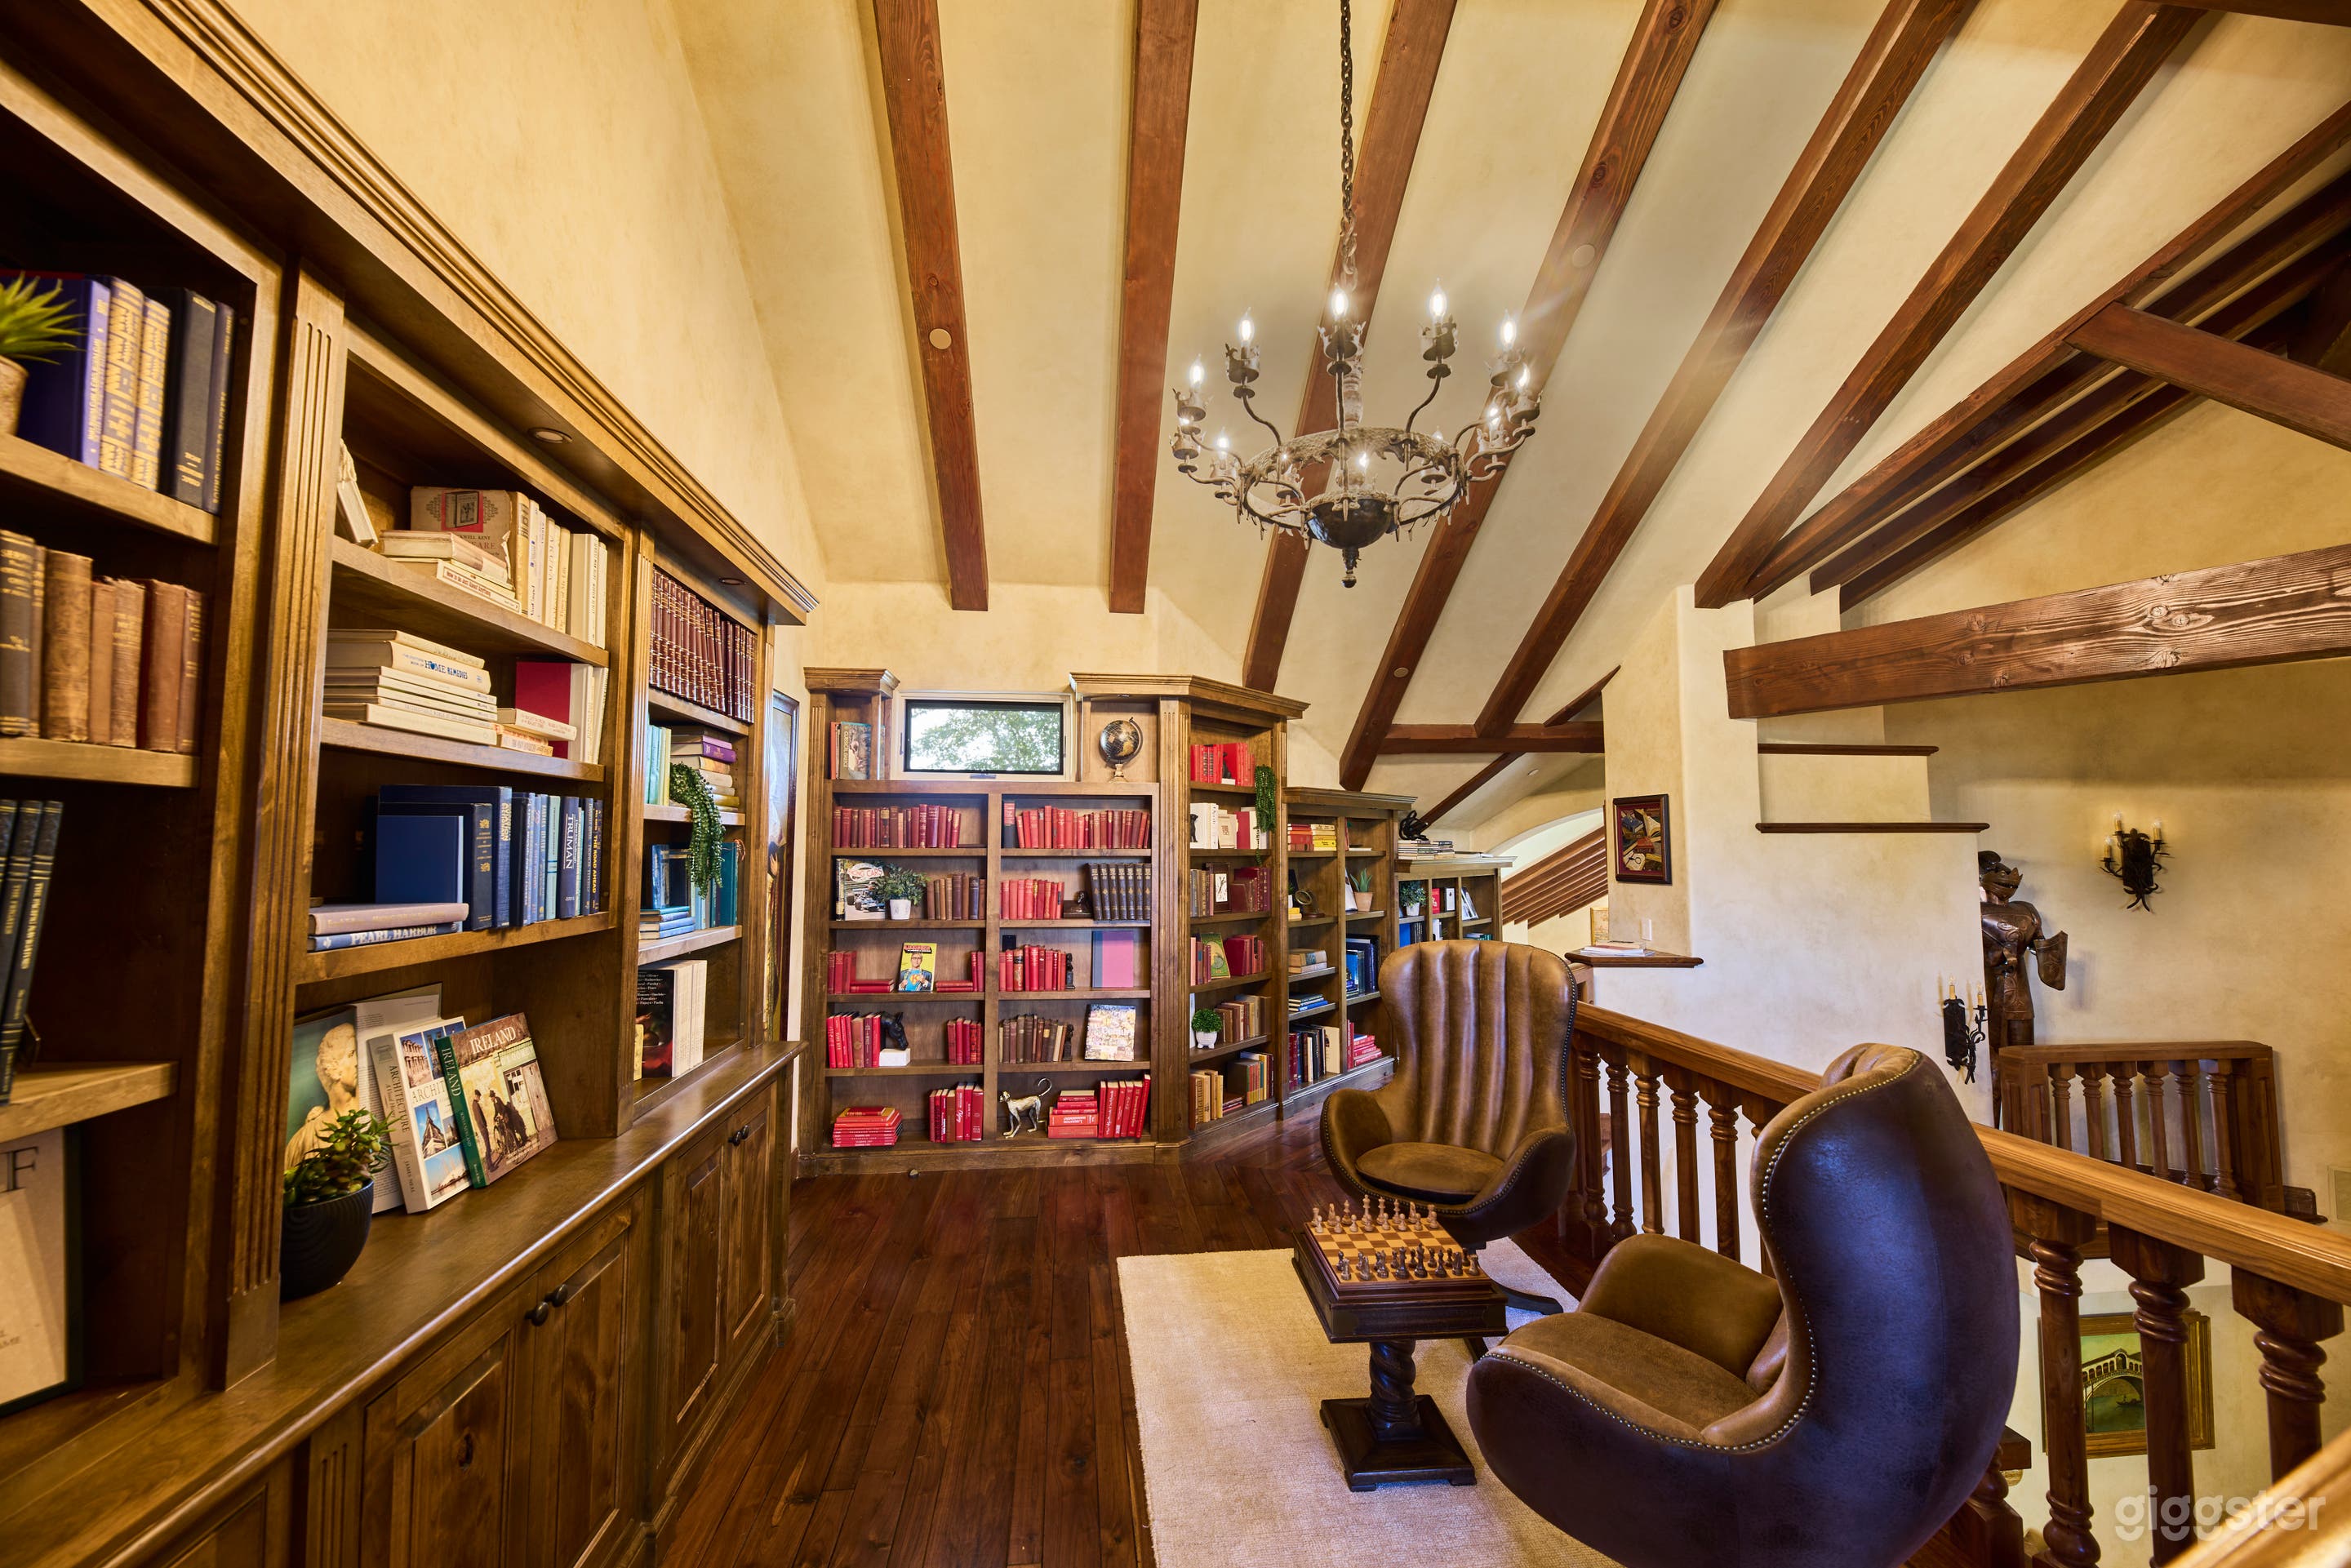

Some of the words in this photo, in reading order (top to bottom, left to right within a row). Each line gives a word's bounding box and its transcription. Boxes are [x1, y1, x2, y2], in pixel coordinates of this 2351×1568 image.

[566, 817, 574, 868] TRUMAN
[867, 867, 882, 877] CARS
[349, 929, 392, 945] PEARL
[393, 924, 438, 939] HARBOR
[469, 1026, 517, 1055] IRELAND
[442, 1047, 462, 1097] IRELAND
[389, 1065, 410, 1133] ARCHITECTURE
[411, 1082, 447, 1104] ARCHIT
